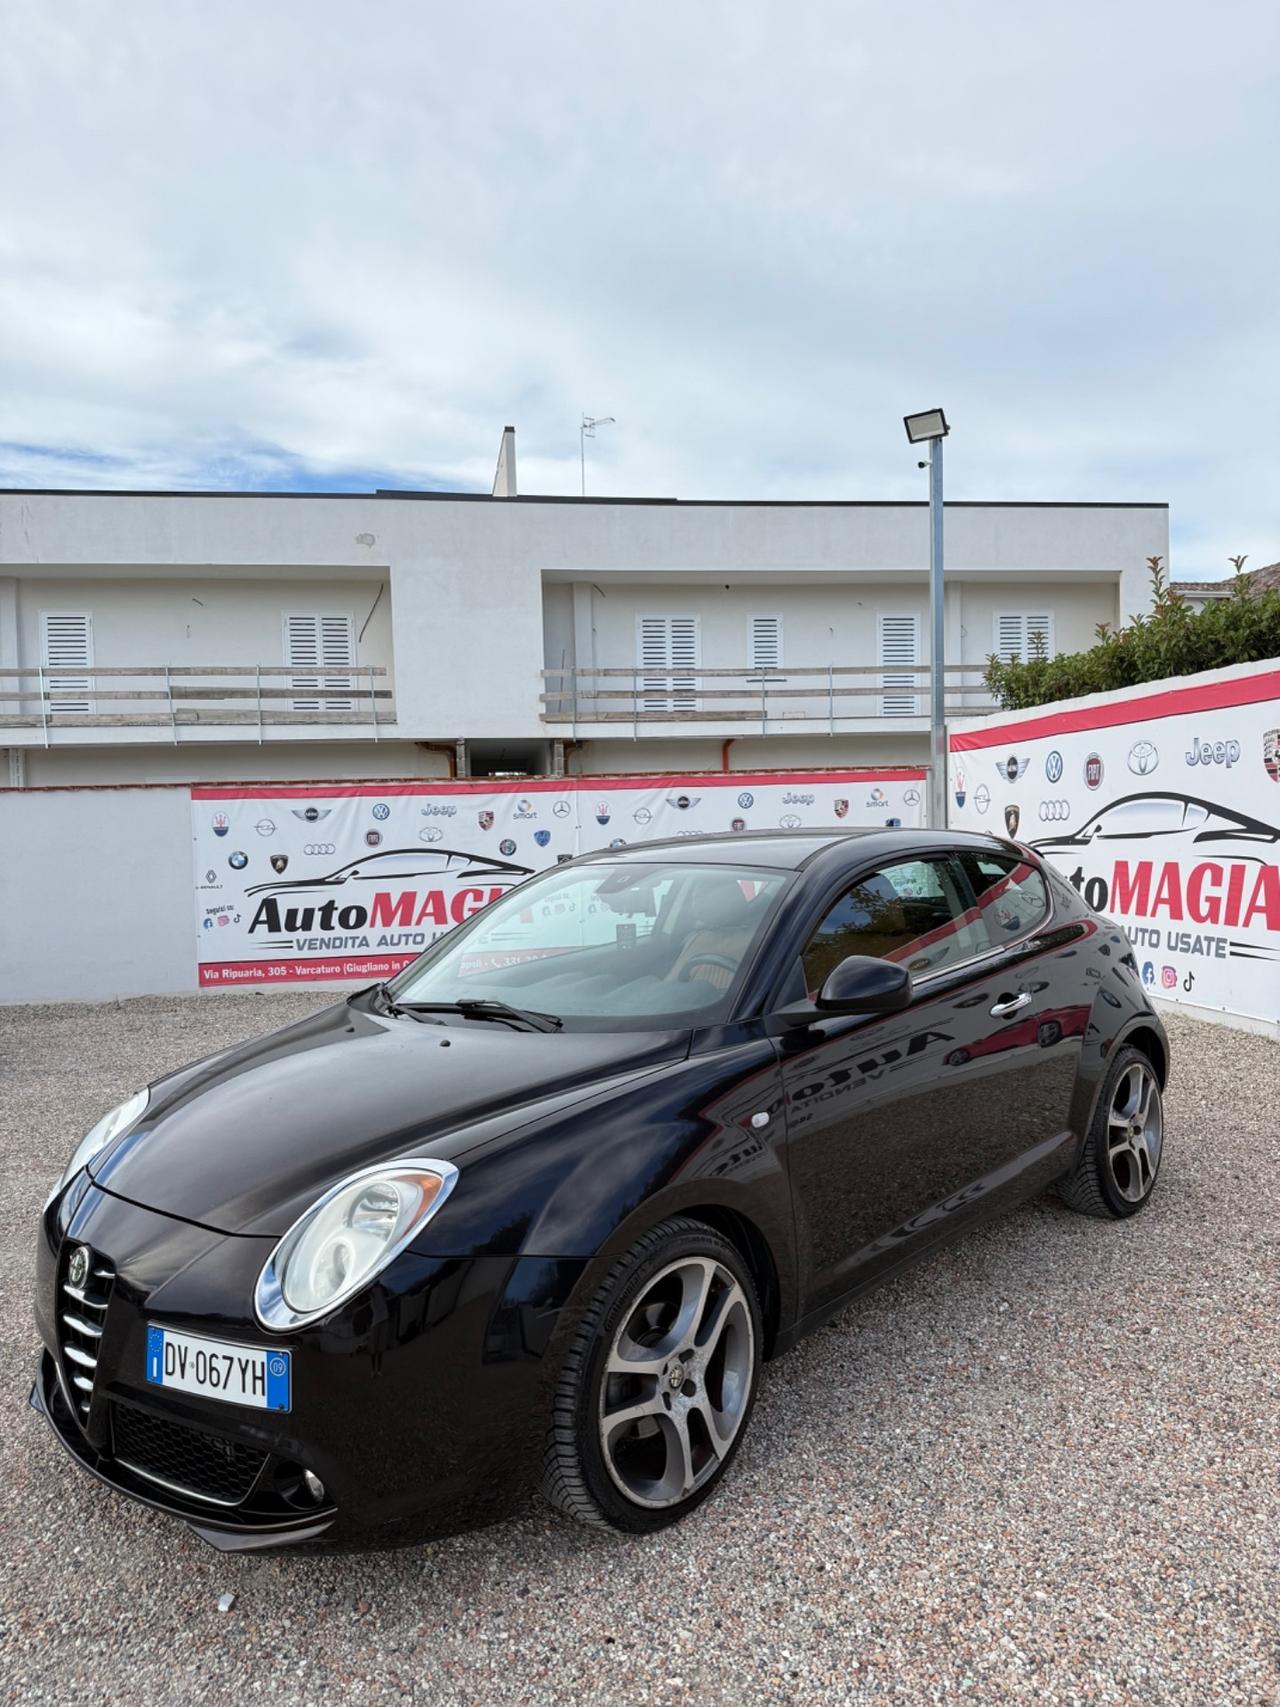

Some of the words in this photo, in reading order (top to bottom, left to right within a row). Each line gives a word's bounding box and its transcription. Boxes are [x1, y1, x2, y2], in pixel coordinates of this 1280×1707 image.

[1185, 737, 1241, 768] Jeep
[782, 792, 815, 805] Jeep
[866, 800, 889, 808] smart
[421, 803, 457, 817] Jeep
[513, 811, 538, 819] smart
[1068, 860, 1280, 932] toMAGIA
[248, 887, 503, 934] AutoMAG
[296, 935, 370, 951] VENDITA
[376, 933, 425, 947] AUTO
[1122, 925, 1161, 949] UTO
[1167, 931, 1228, 959] USATE
[203, 969, 219, 979] Via
[222, 968, 265, 980] Ripuaria,
[267, 966, 287, 976] 305
[295, 964, 341, 975] Varcaturo
[343, 962, 389, 975] (Giugliano
[392, 960, 400, 969] in
